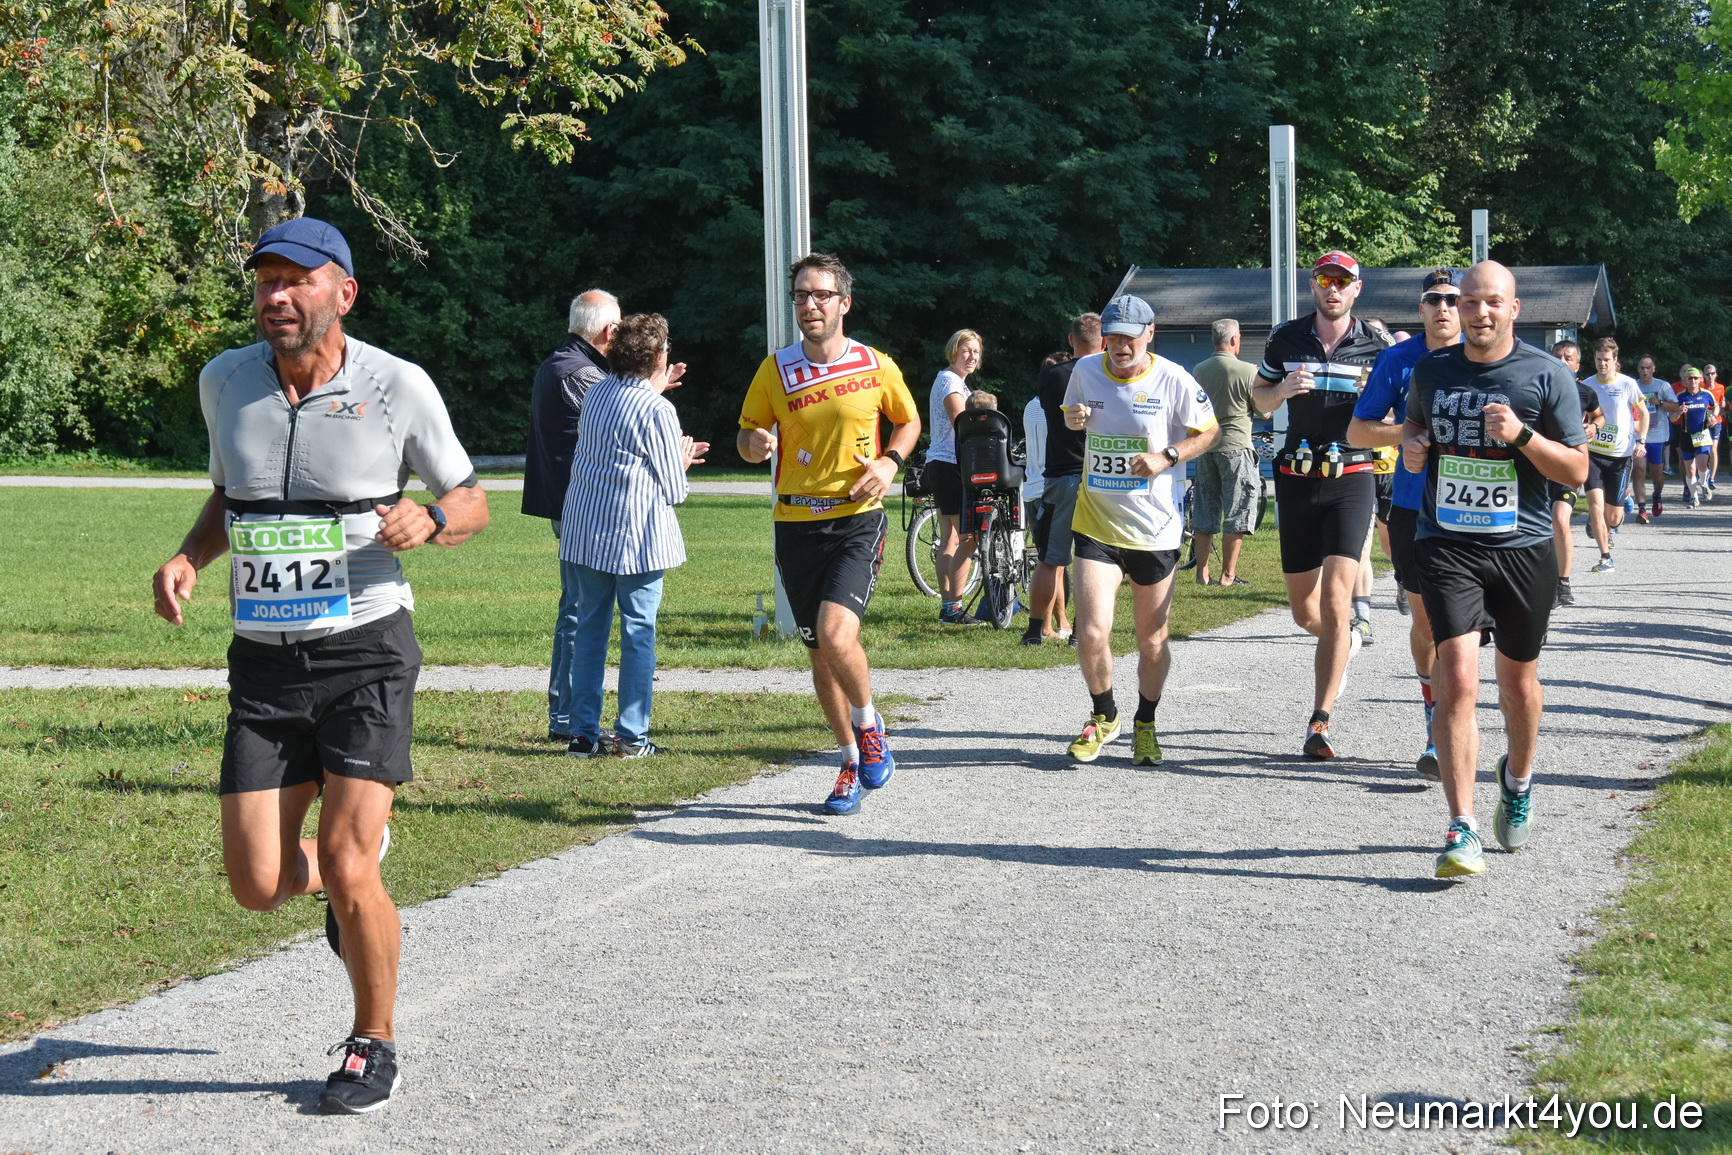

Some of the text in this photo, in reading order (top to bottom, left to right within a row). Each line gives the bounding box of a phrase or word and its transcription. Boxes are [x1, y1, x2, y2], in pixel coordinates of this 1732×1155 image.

[787, 376, 881, 413] MAX BÖGL
[1135, 394, 1147, 402] 20
[1091, 436, 1143, 451] BOCK
[1093, 455, 1134, 474] 233
[1444, 459, 1510, 479] BOCK
[1093, 478, 1140, 488] REINHARD
[1445, 482, 1507, 507] 2426
[1456, 512, 1491, 524] JÖRG
[233, 525, 334, 551] BOCK
[242, 559, 333, 593] 2412
[252, 601, 329, 619] JOACHIM
[344, 757, 371, 766] patagonia
